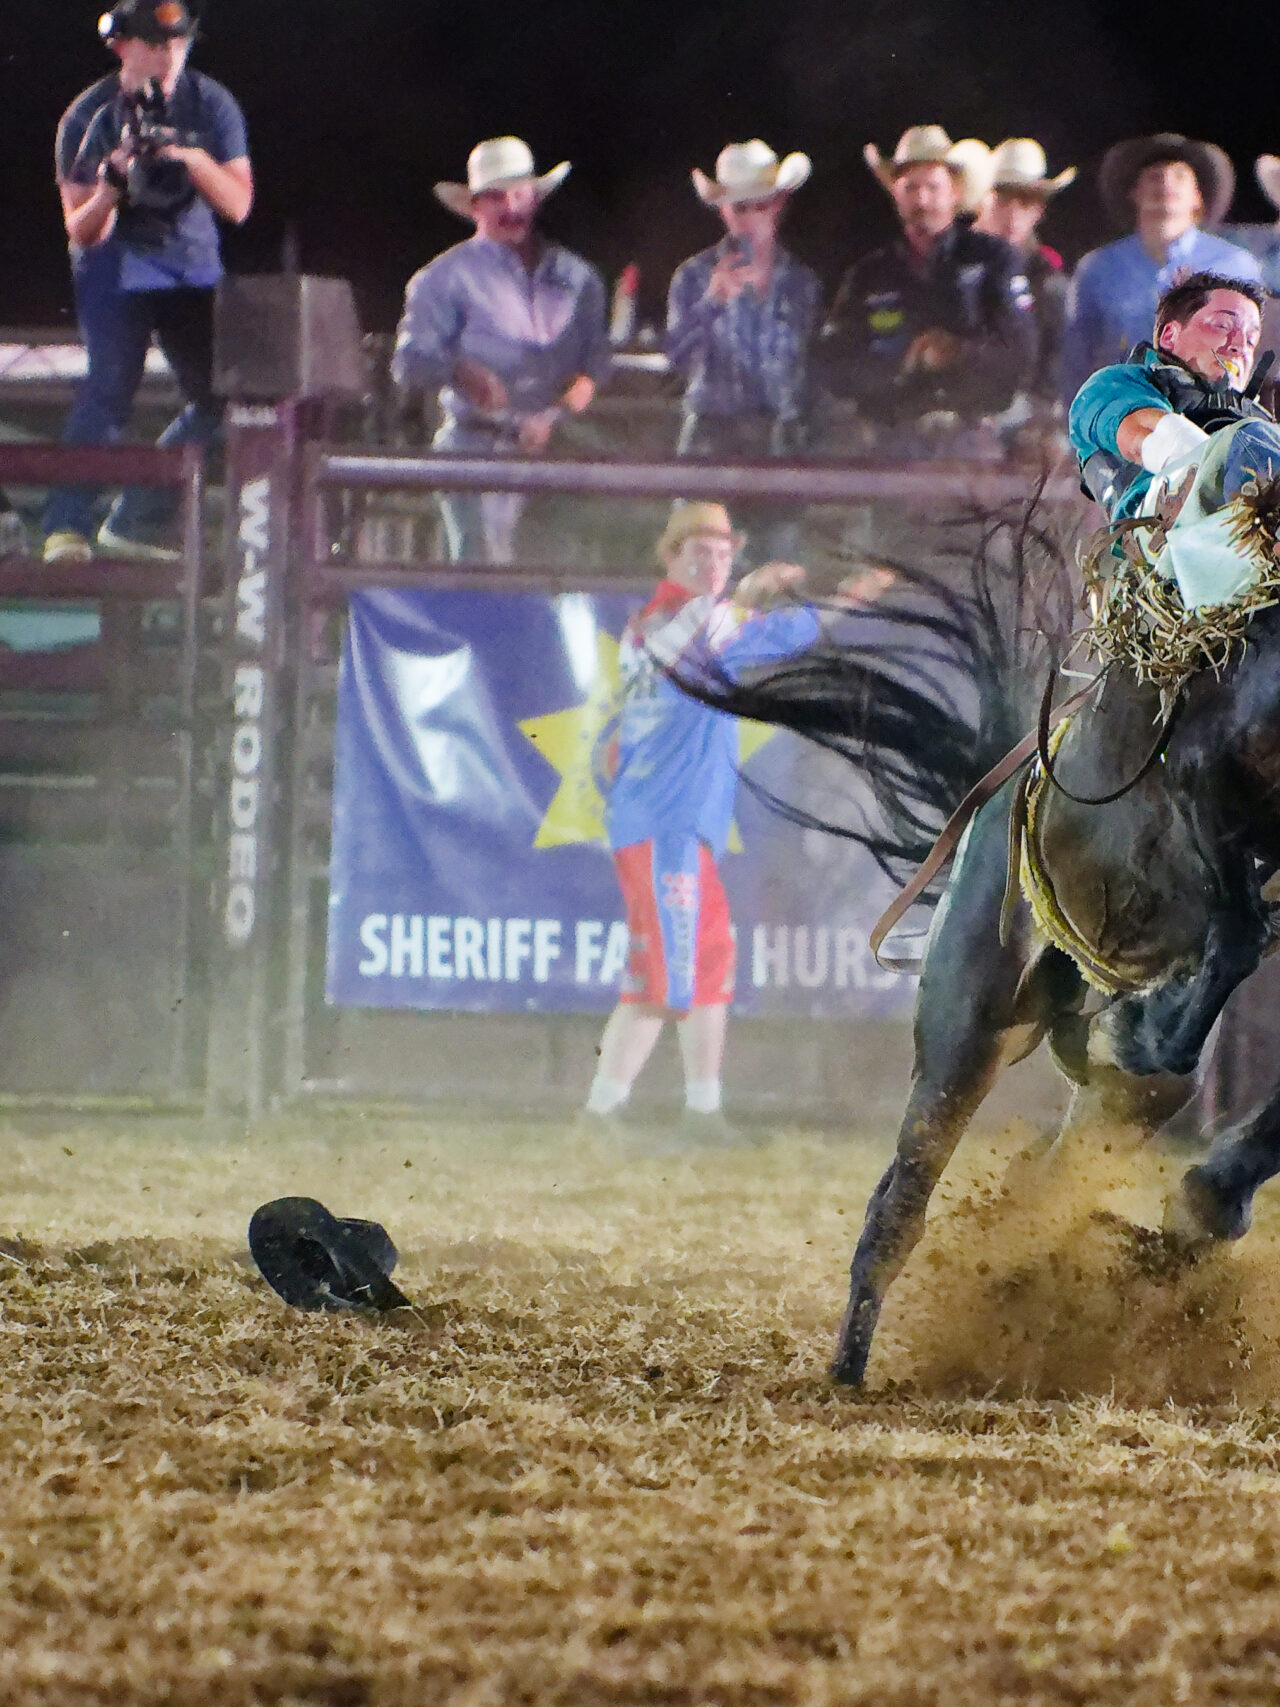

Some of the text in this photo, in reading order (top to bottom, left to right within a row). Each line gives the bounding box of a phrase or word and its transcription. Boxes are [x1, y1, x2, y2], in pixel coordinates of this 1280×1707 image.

[225, 477, 271, 938] W-W RODEO
[358, 912, 562, 984] SHERIFF
[752, 923, 920, 990] HUR
